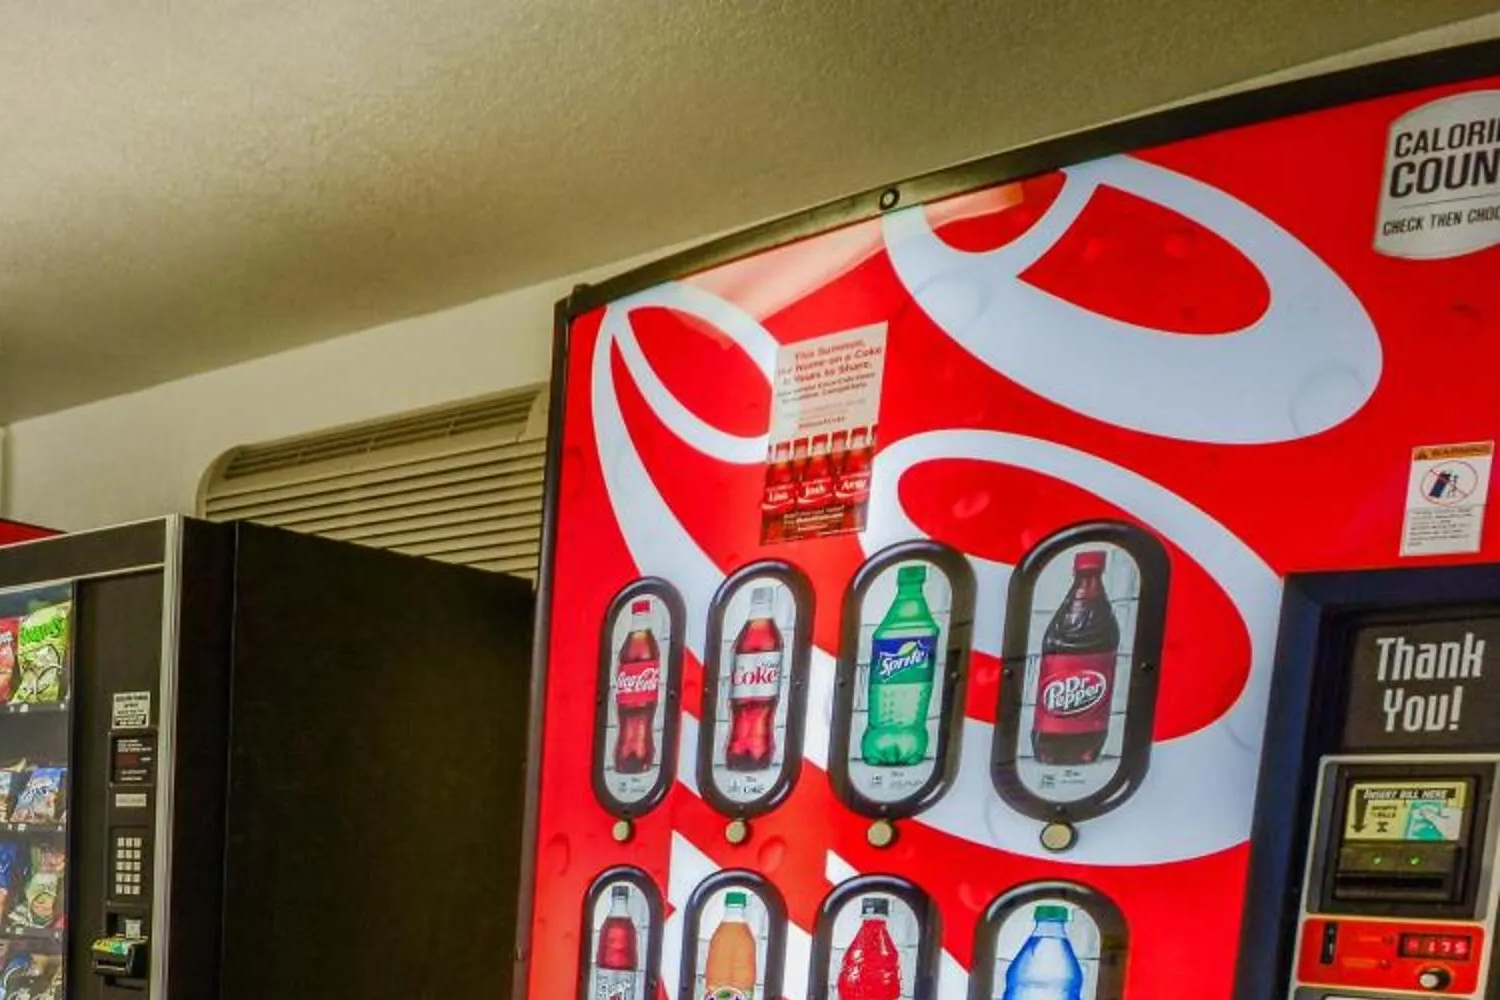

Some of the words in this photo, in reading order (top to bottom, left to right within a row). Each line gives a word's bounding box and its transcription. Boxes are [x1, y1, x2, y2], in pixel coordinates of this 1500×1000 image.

[1382, 217, 1425, 237] CHECK
[1430, 210, 1463, 230] THEN
[878, 648, 927, 683] Sprite
[1376, 632, 1487, 682] Thank
[731, 665, 777, 687] Coke
[1063, 674, 1090, 694] Dr
[1047, 682, 1104, 712] Pepper
[1383, 685, 1464, 733] You!
[1399, 788, 1420, 800] BILL
[1421, 787, 1449, 800] HERE
